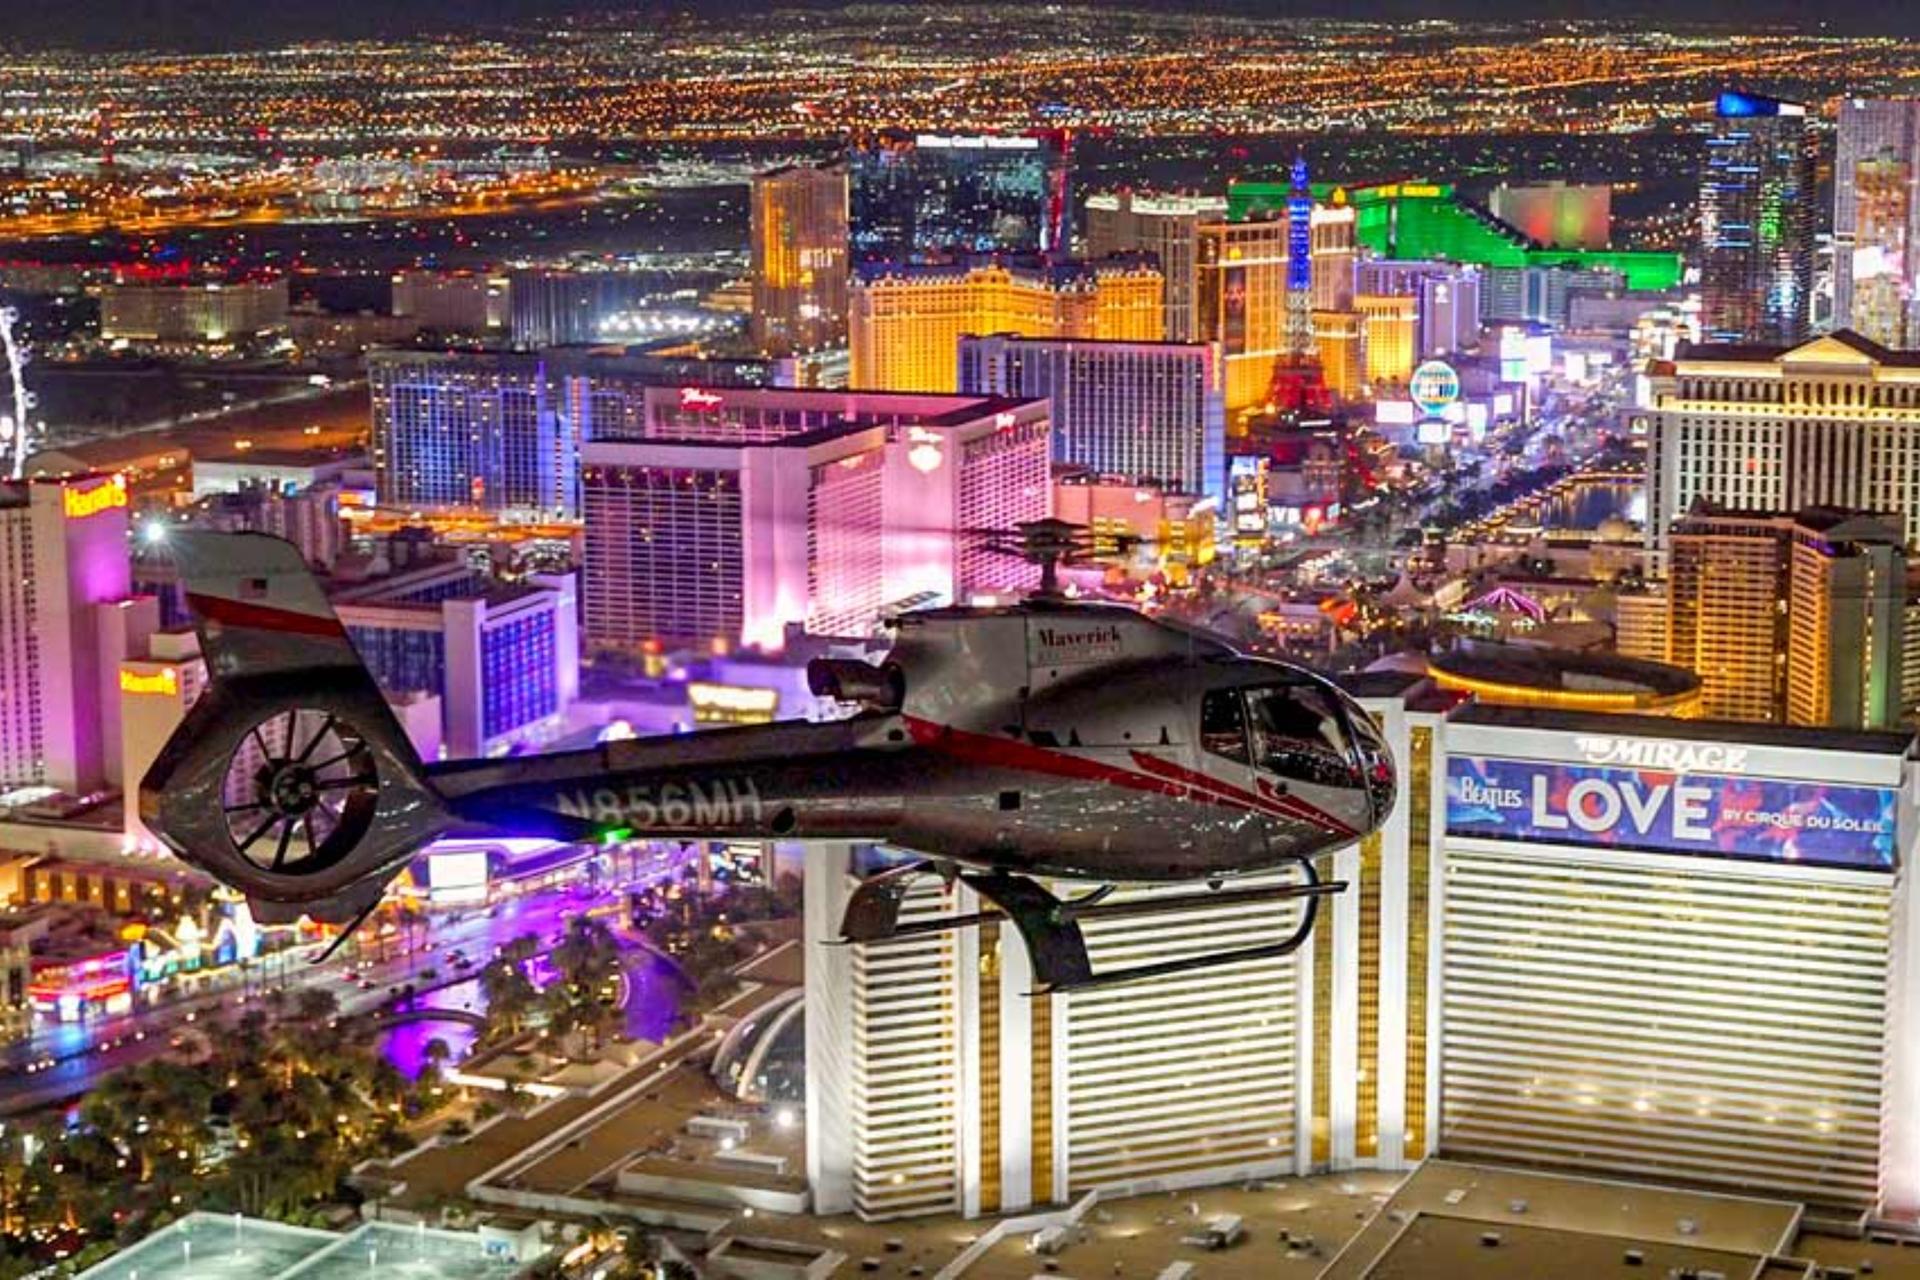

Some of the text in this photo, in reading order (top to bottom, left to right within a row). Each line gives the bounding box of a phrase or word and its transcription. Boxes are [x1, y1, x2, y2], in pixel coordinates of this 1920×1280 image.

[1038, 625, 1121, 648] Maverick
[1586, 738, 1749, 772] MIRAGE
[555, 776, 764, 828] N856MH
[1532, 774, 1712, 841] LOVE
[1744, 809, 1803, 829] CIRQUE
[1806, 815, 1831, 829] DU
